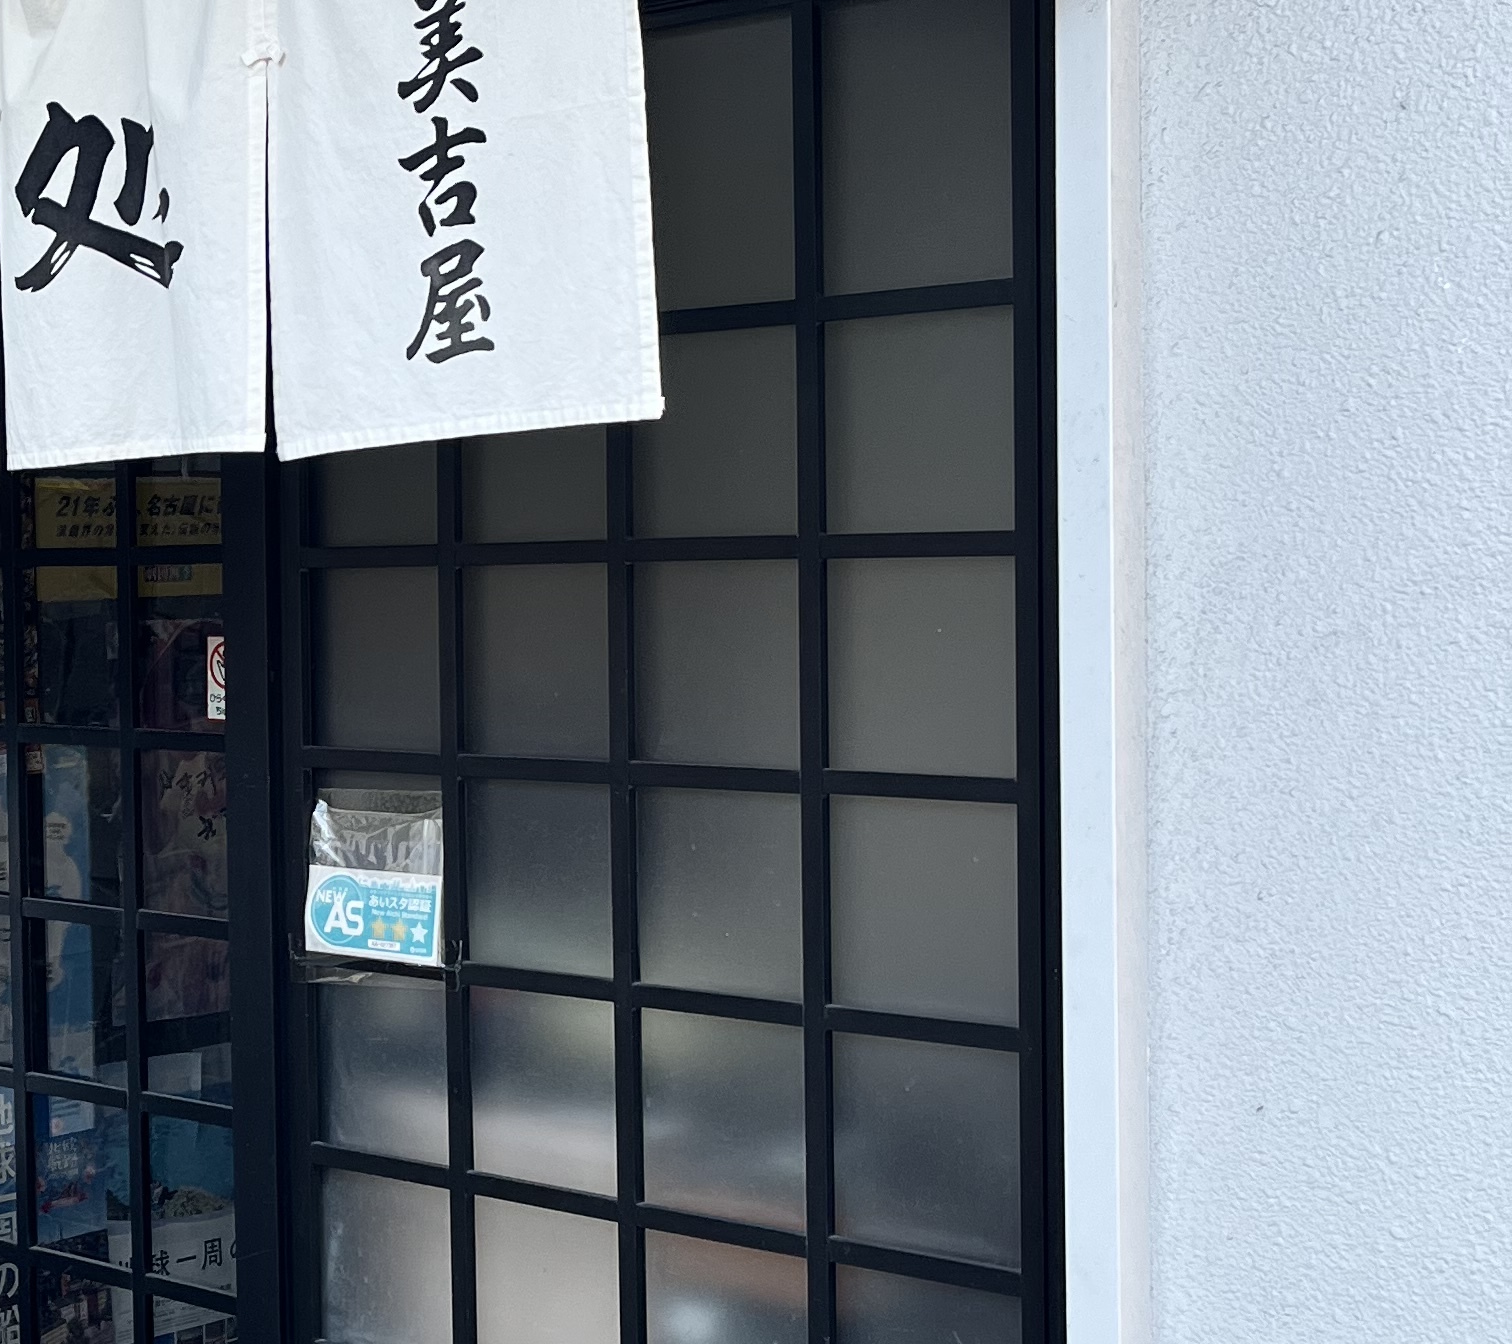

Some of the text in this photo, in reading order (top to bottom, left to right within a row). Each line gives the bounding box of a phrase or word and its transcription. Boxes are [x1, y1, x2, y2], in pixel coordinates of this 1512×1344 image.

[315, 889, 348, 905] NEW
[368, 895, 432, 913] あいスタ認証
[323, 900, 364, 937] AS
